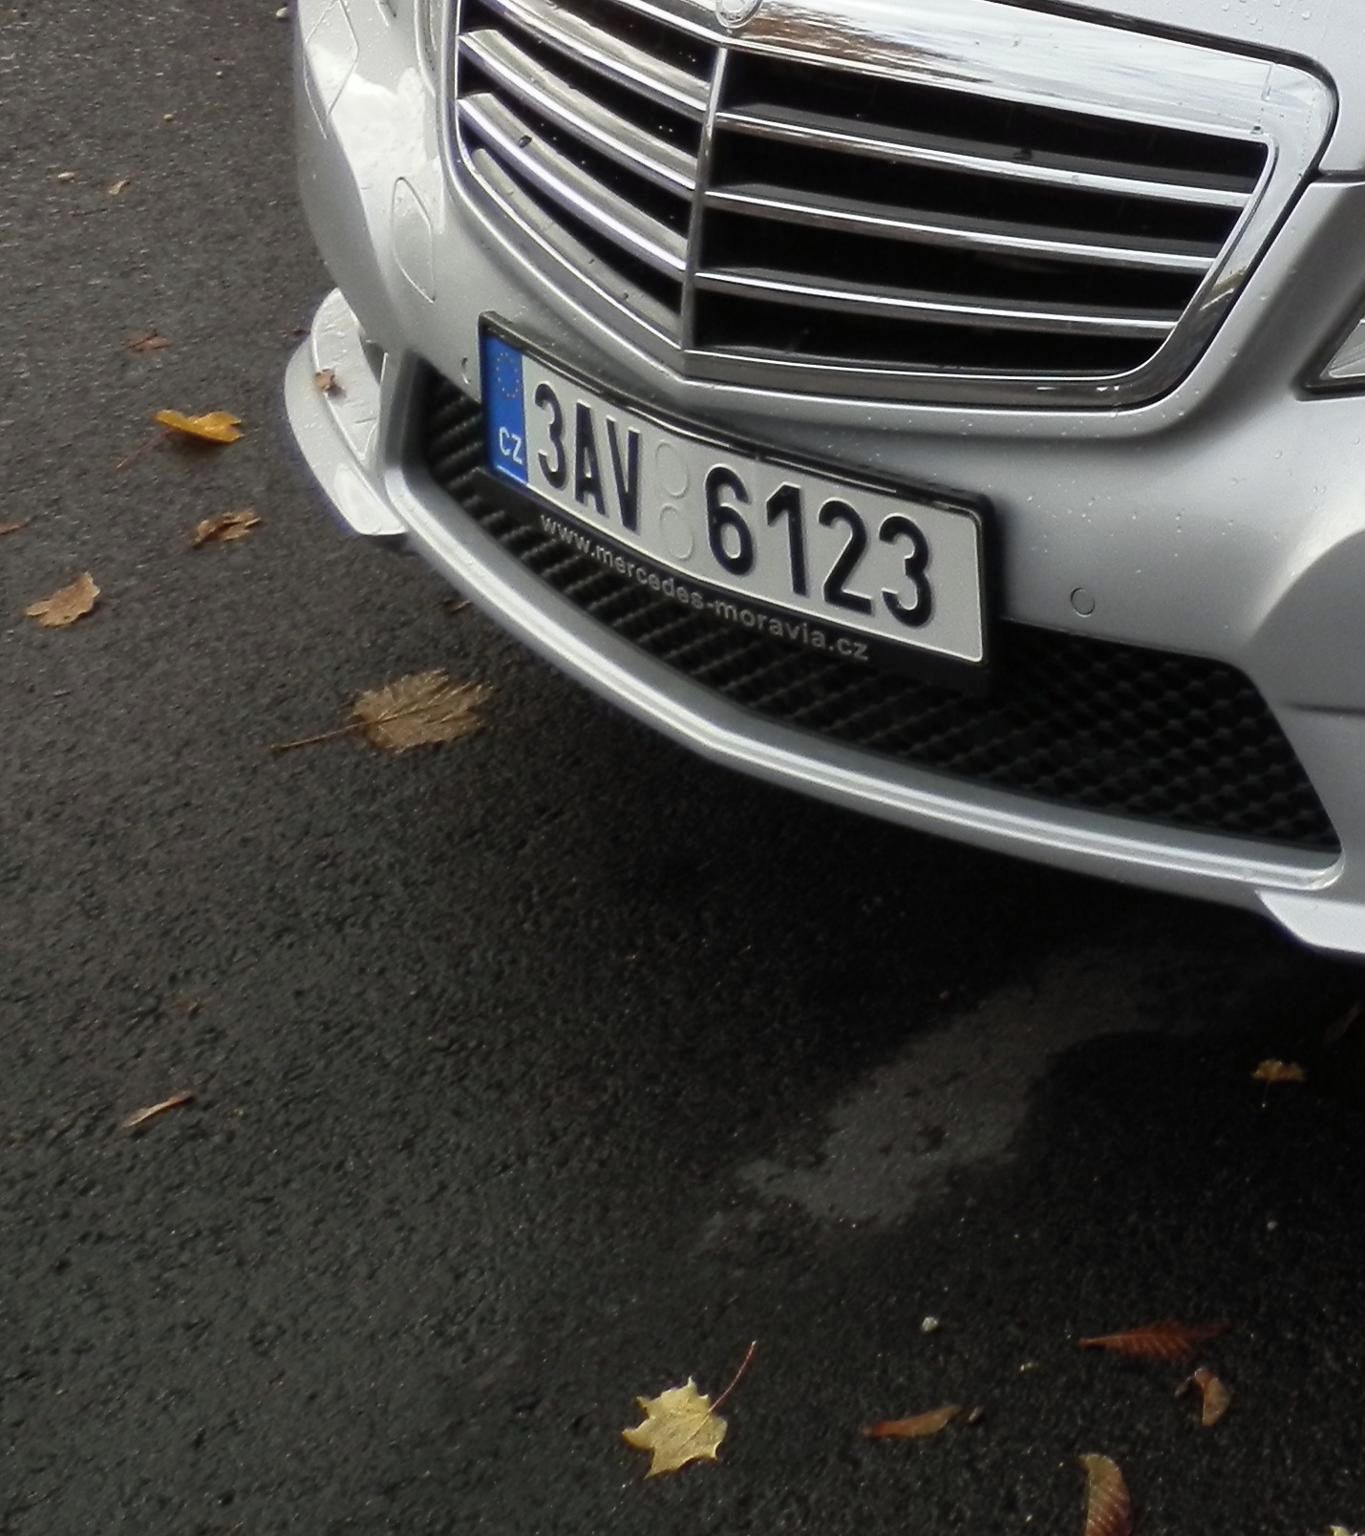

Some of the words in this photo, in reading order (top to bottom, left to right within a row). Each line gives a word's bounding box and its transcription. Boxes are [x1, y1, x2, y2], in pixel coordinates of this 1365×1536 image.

[499, 425, 523, 465] CZ
[534, 382, 643, 537] 3AV
[704, 463, 934, 629] 6123
[540, 514, 870, 662] www.mercedes-moravia.cz
